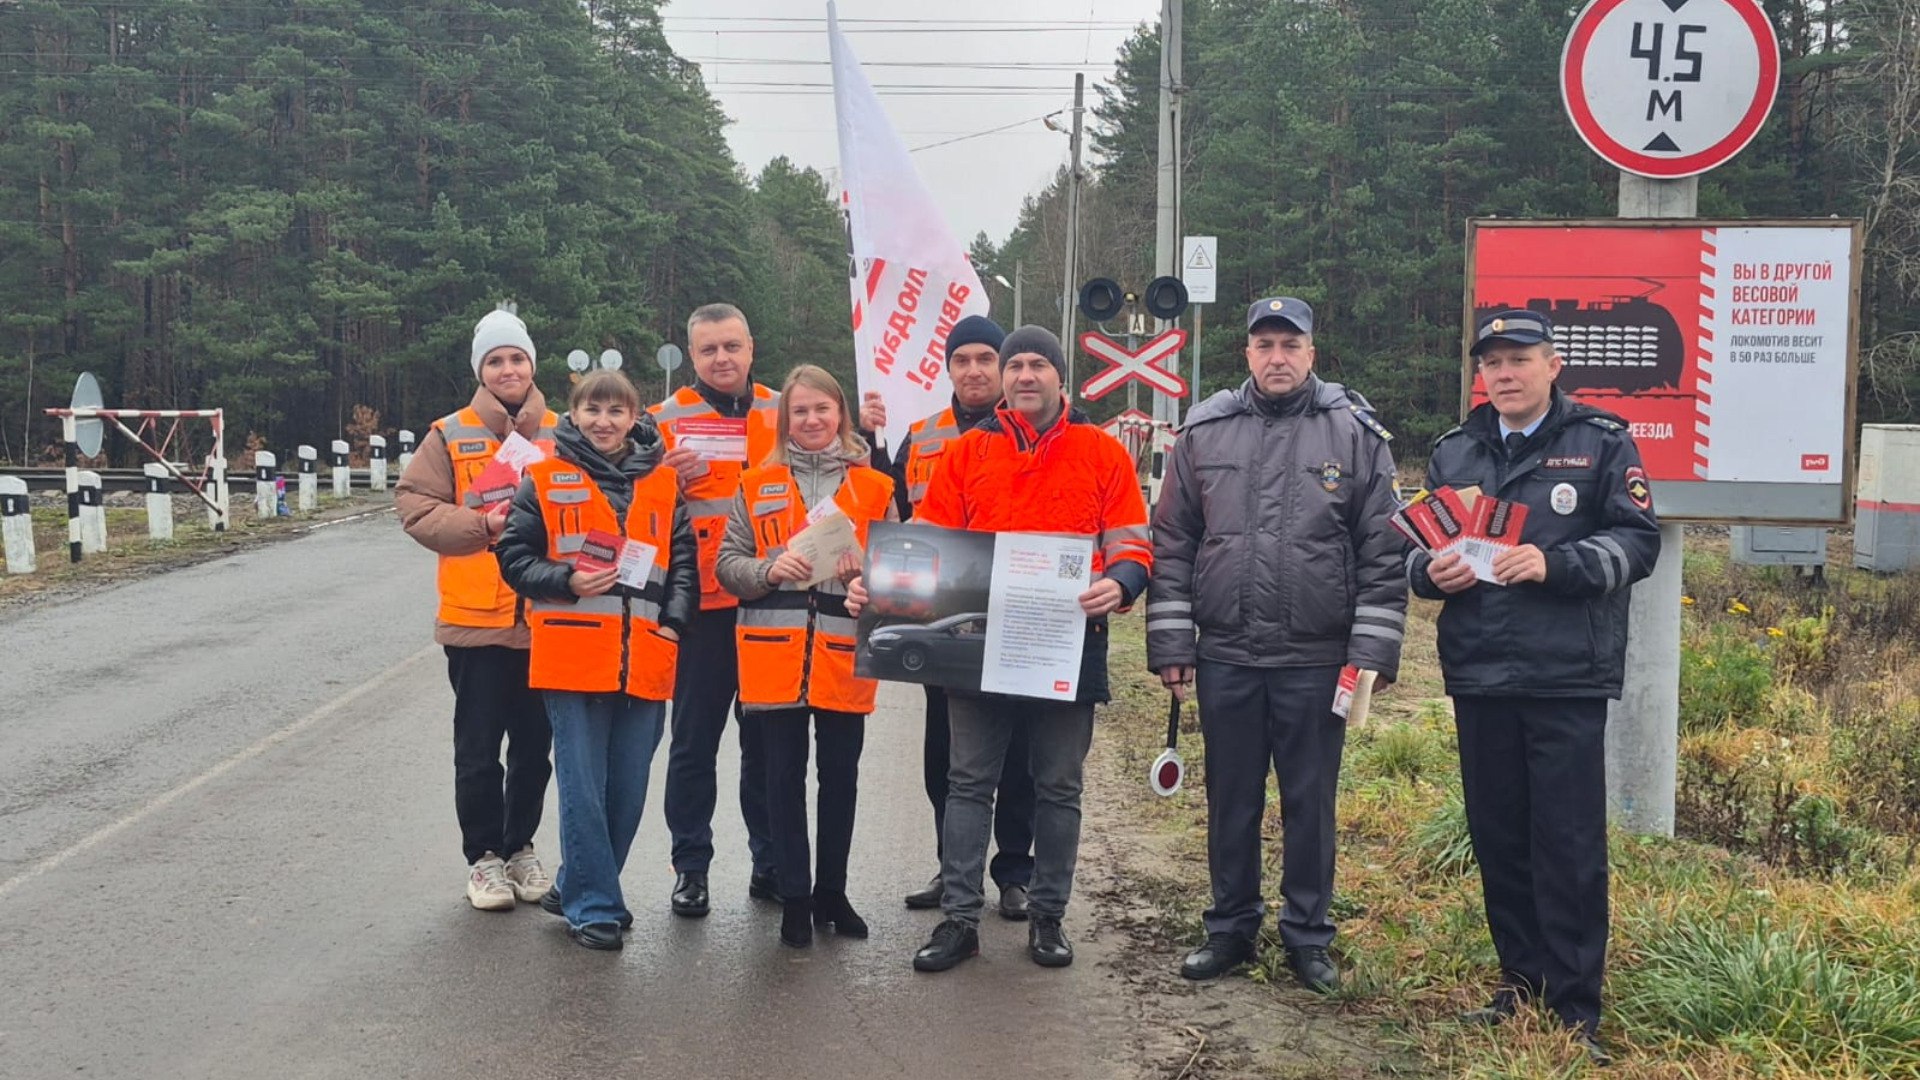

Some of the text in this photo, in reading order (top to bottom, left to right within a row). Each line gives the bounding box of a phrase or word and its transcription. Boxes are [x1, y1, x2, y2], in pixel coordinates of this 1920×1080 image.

[1646, 89, 1682, 122] М
[1733, 260, 1832, 282] ВЫ В ДРУГОЙ
[1732, 283, 1799, 303] ВЕСОВОЙ
[1731, 308, 1816, 325] КАТЕГОРИИ
[1730, 335, 1824, 347] ЛОКОМОТИВ ВЕСИТ
[1729, 351, 1817, 364] В 50 РАЗ БОЛЬШЕ
